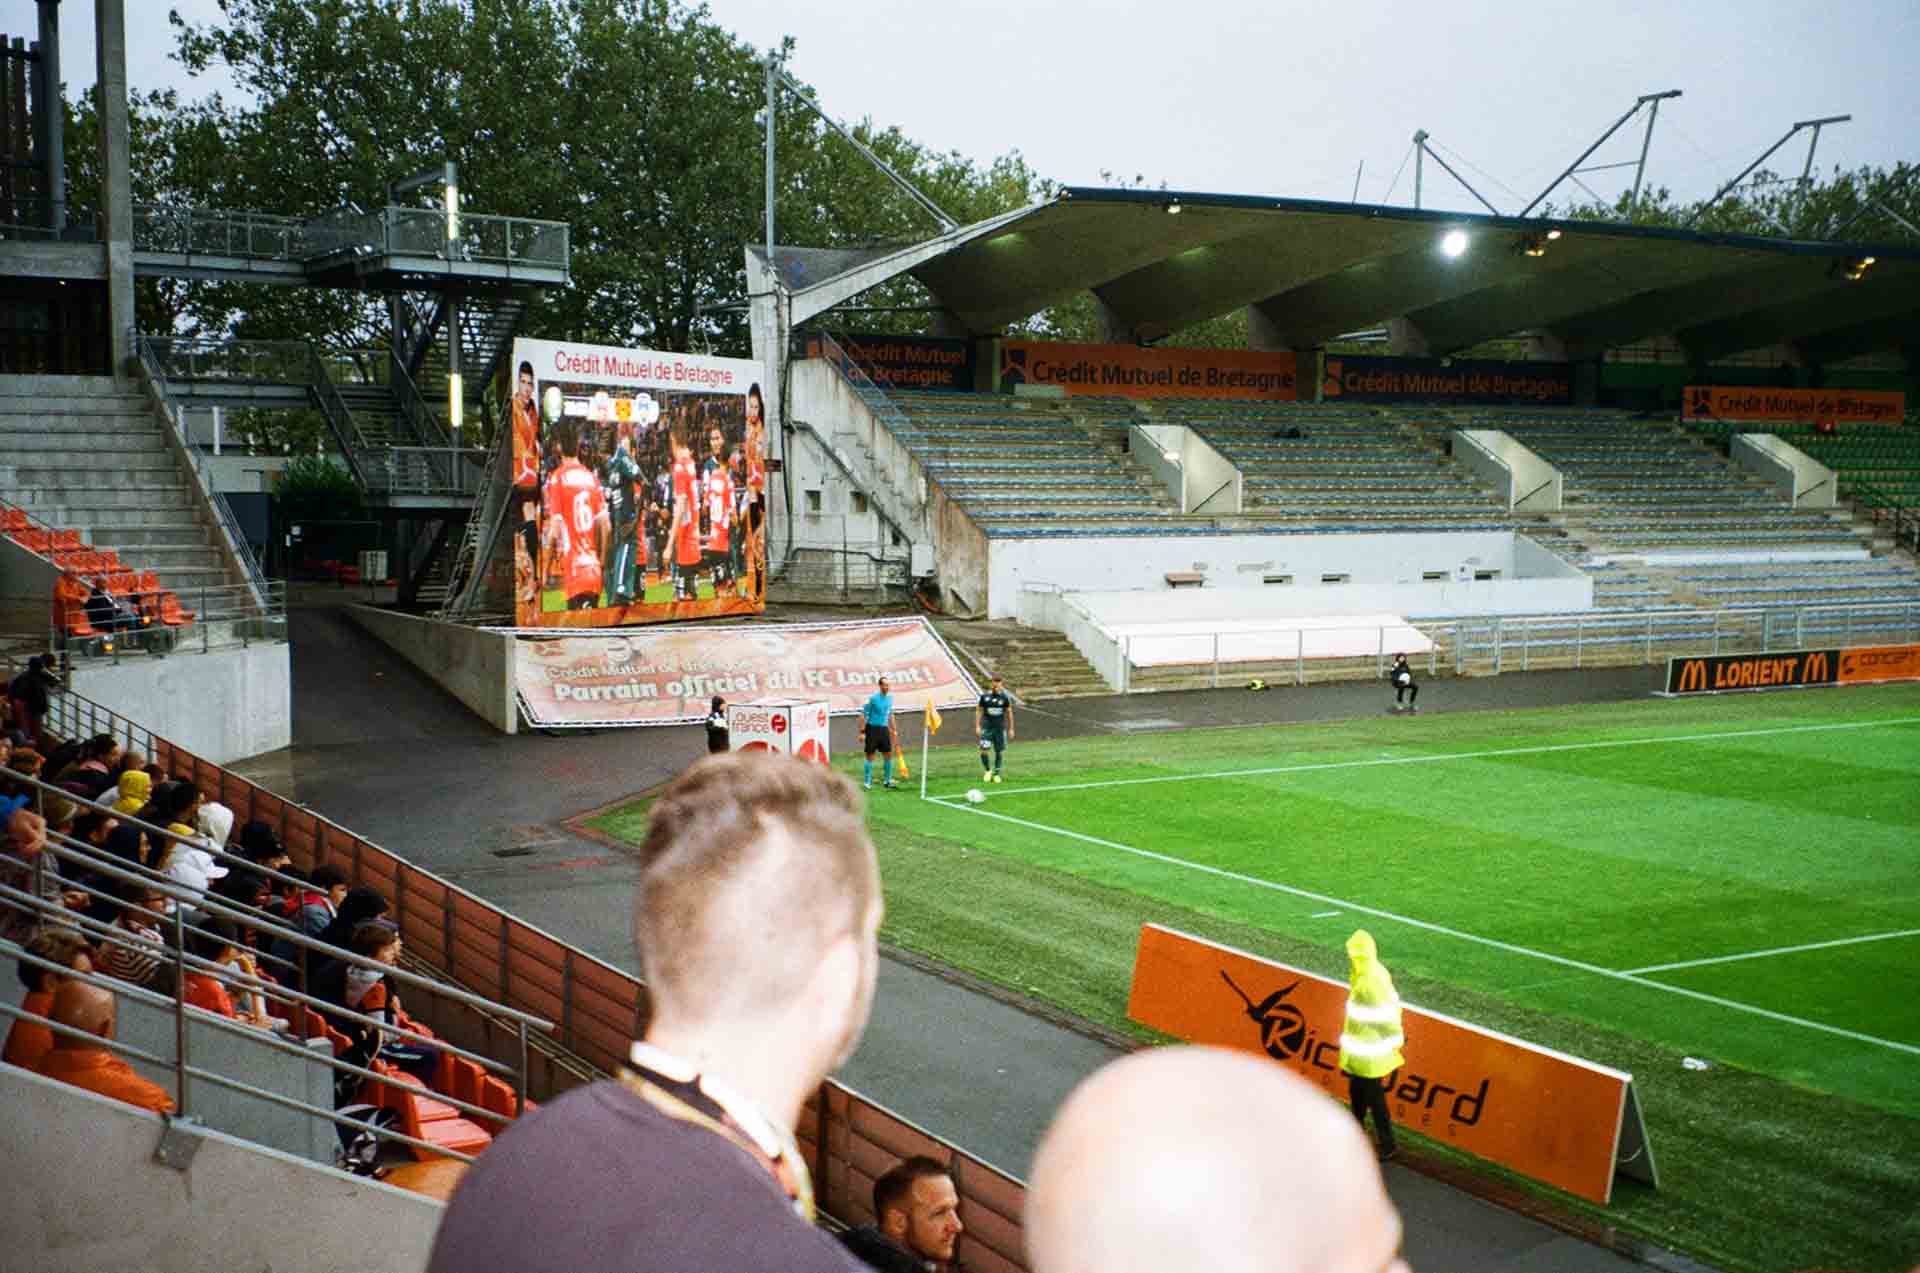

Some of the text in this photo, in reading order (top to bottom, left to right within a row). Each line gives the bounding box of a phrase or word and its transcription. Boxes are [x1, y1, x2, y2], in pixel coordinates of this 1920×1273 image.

[554, 350, 733, 388] Crédit Mutuel de Bretagne
[847, 343, 968, 364] Crédit Mutuel
[872, 366, 953, 387] Bretagne
[1032, 358, 1295, 392] Crédit Mutuel de Bretagne
[1344, 370, 1569, 400] Crédit Mutuel de Bretagne
[572, 489, 593, 533] 6
[554, 676, 657, 702] Parrain
[664, 672, 758, 700] officiel
[803, 670, 834, 689] FC
[1714, 658, 1797, 688] LORIENT
[1259, 1002, 1490, 1127] Ricard
